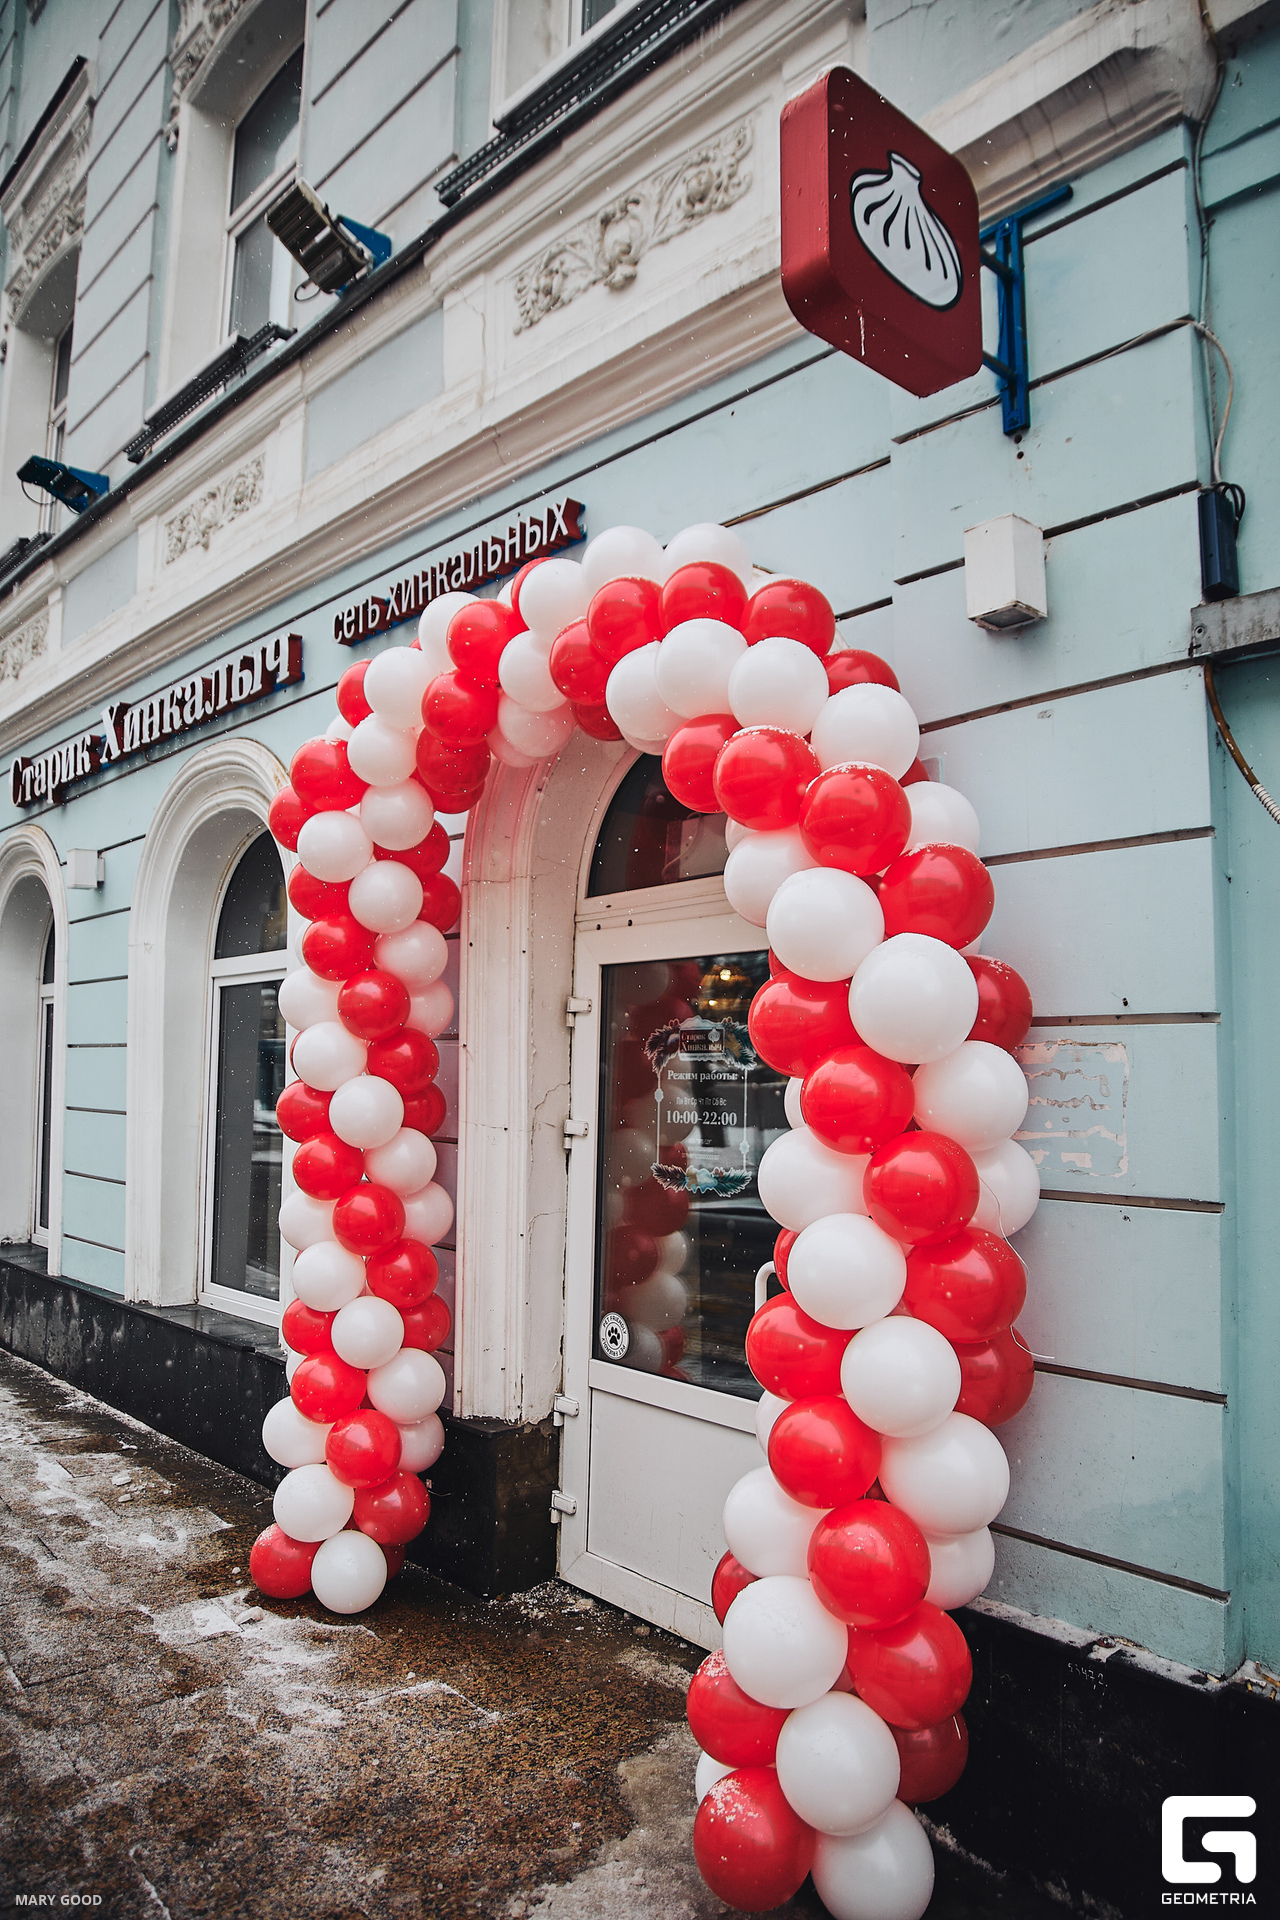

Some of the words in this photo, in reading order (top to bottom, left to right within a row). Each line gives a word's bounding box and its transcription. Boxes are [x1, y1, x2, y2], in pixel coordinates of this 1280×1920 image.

[333, 596, 380, 643] сеть
[386, 497, 569, 620] хинкальных
[9, 734, 92, 806] Старик
[100, 632, 291, 764] Хинкалыч
[667, 1069, 698, 1080] Режим
[700, 1069, 738, 1082] работы:
[666, 1110, 738, 1126] 10:00-22:00
